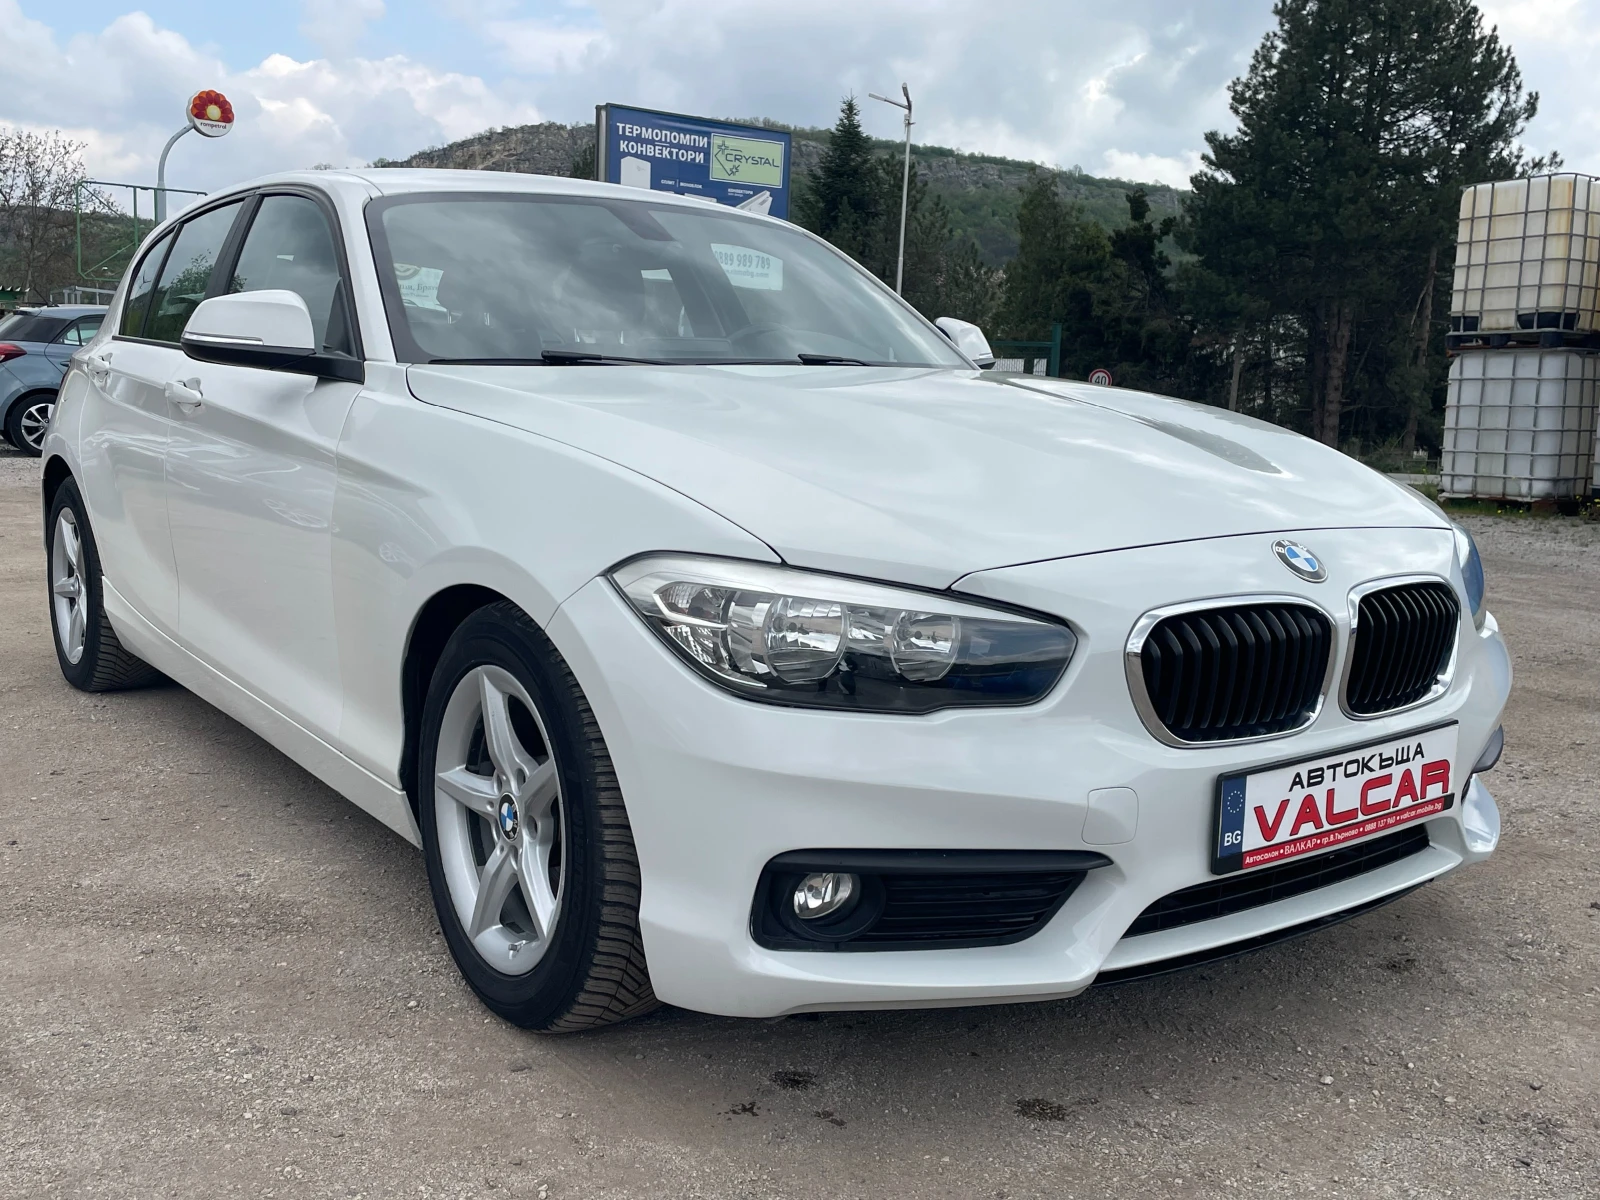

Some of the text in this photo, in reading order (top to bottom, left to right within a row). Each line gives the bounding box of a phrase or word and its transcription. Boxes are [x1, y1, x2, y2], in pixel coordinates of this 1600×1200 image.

[616, 122, 708, 148] ТЕРМОПОМПИ
[619, 139, 705, 164] КОНВЕКТОРИ
[725, 152, 780, 168] CRYSTAL
[736, 253, 753, 268] 989
[755, 255, 771, 270] 789
[1094, 375, 1107, 385] 40
[1288, 742, 1425, 793] АВТОКЪЩА
[1253, 758, 1451, 843] VALCAR
[1223, 830, 1242, 847] BG
[1244, 849, 1279, 865] Автосалон
[1284, 838, 1317, 856] ВАЛКАР
